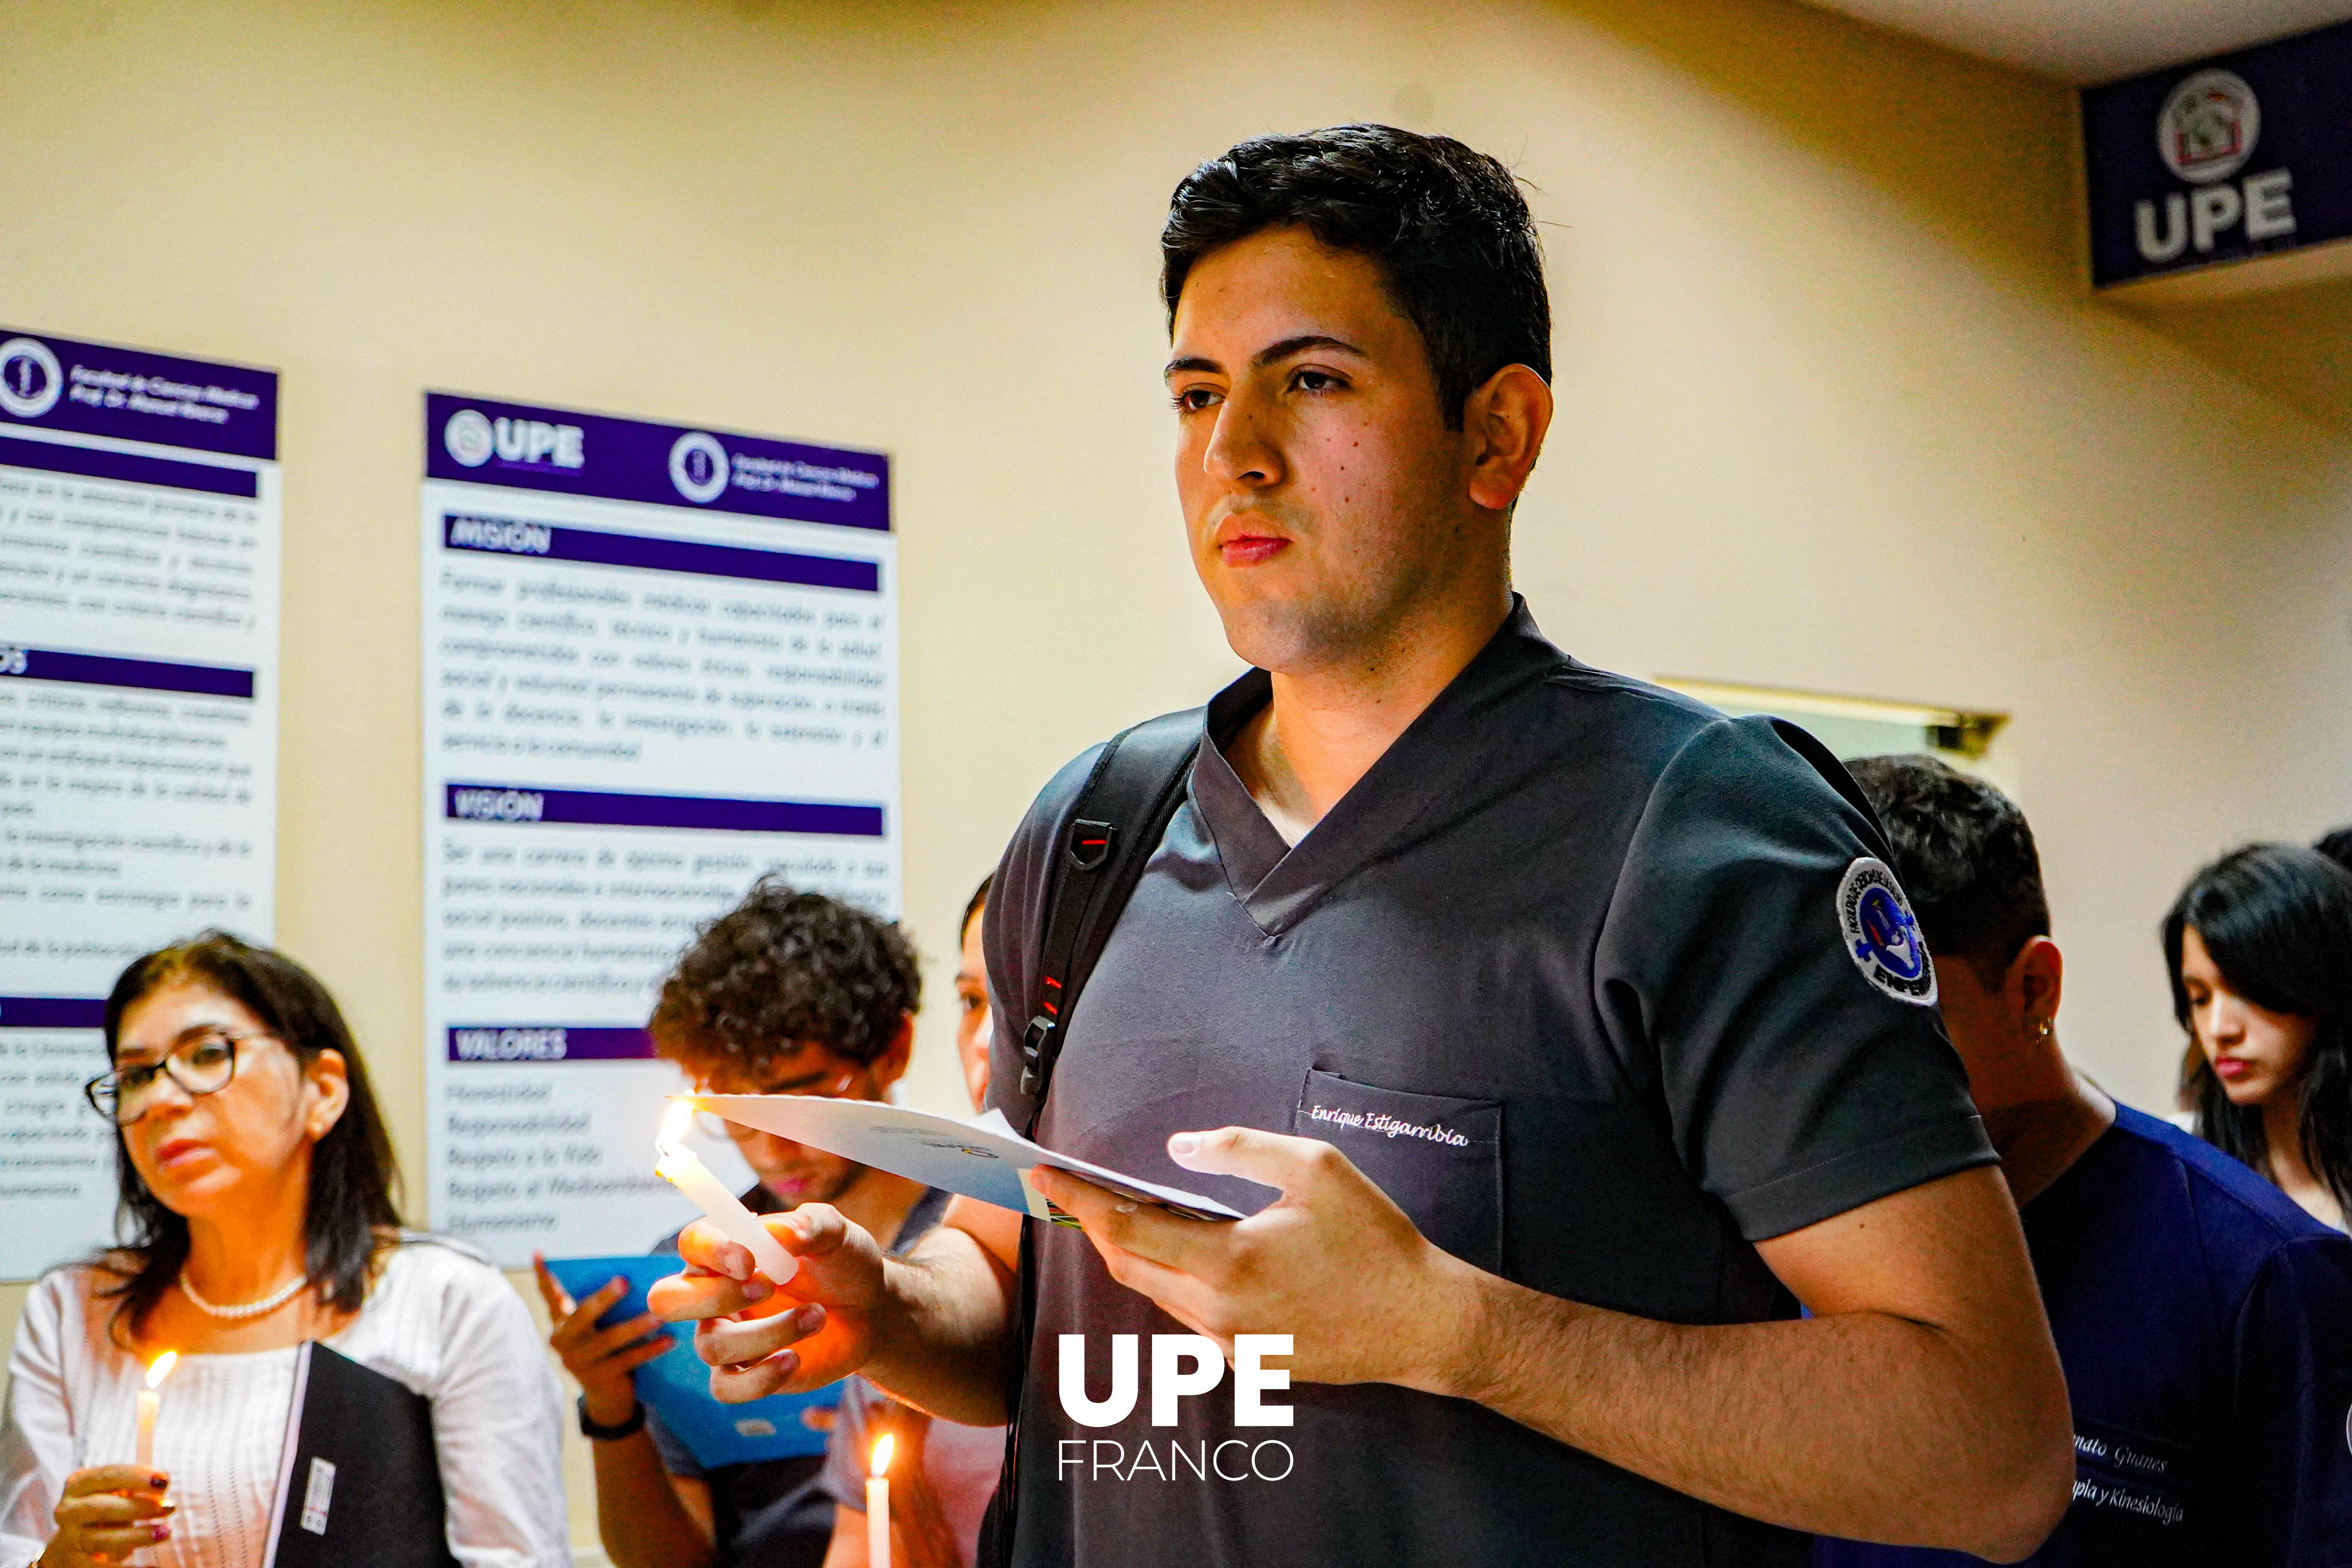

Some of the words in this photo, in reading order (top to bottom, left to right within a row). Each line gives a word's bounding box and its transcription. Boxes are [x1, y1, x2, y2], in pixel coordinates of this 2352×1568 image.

[2134, 167, 2296, 263] UPE
[493, 416, 585, 468] UPE
[456, 1029, 566, 1060] VALORES
[1312, 1105, 1365, 1129] Enrique
[1365, 1112, 1468, 1147] Estigarribia
[2073, 1434, 2107, 1456] nato
[2096, 1488, 2109, 1506] y
[2110, 1488, 2183, 1526] Kinesiología
